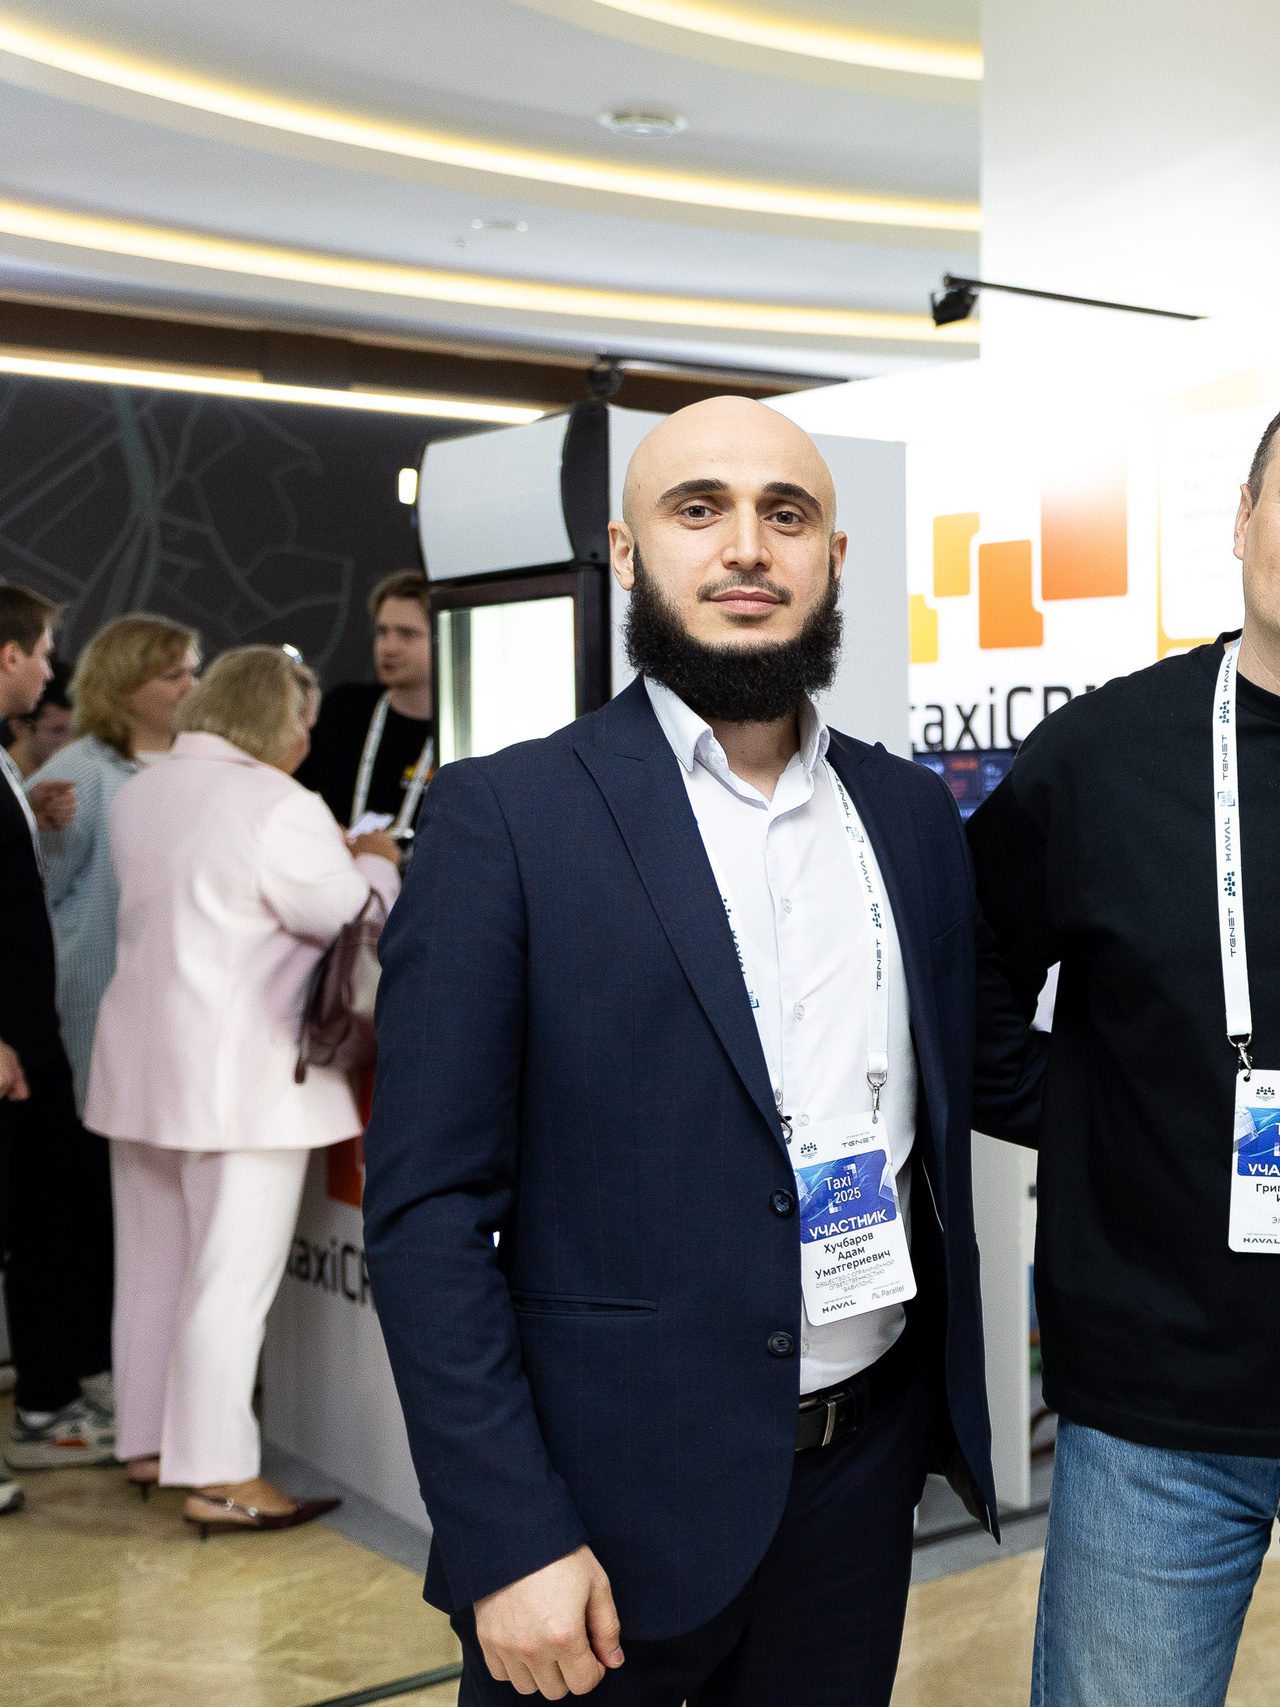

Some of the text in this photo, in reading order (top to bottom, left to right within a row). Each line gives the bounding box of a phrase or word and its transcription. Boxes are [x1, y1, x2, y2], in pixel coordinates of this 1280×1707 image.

[1223, 655, 1233, 692] HAVAL
[834, 775, 851, 818] TENET
[859, 852, 873, 893] HAVAL
[1228, 908, 1237, 957] TENET
[841, 1136, 877, 1148] TENET
[824, 1172, 852, 1191] Taxi
[833, 1187, 861, 1204] 2025
[809, 1208, 888, 1240] УЧАСТНИК
[823, 1232, 874, 1254] Хучбаров
[837, 1246, 866, 1262] Адам
[815, 1249, 891, 1280] Уматгериевич
[881, 1285, 905, 1297] Parallel
[822, 1300, 857, 1314] HAVAL
